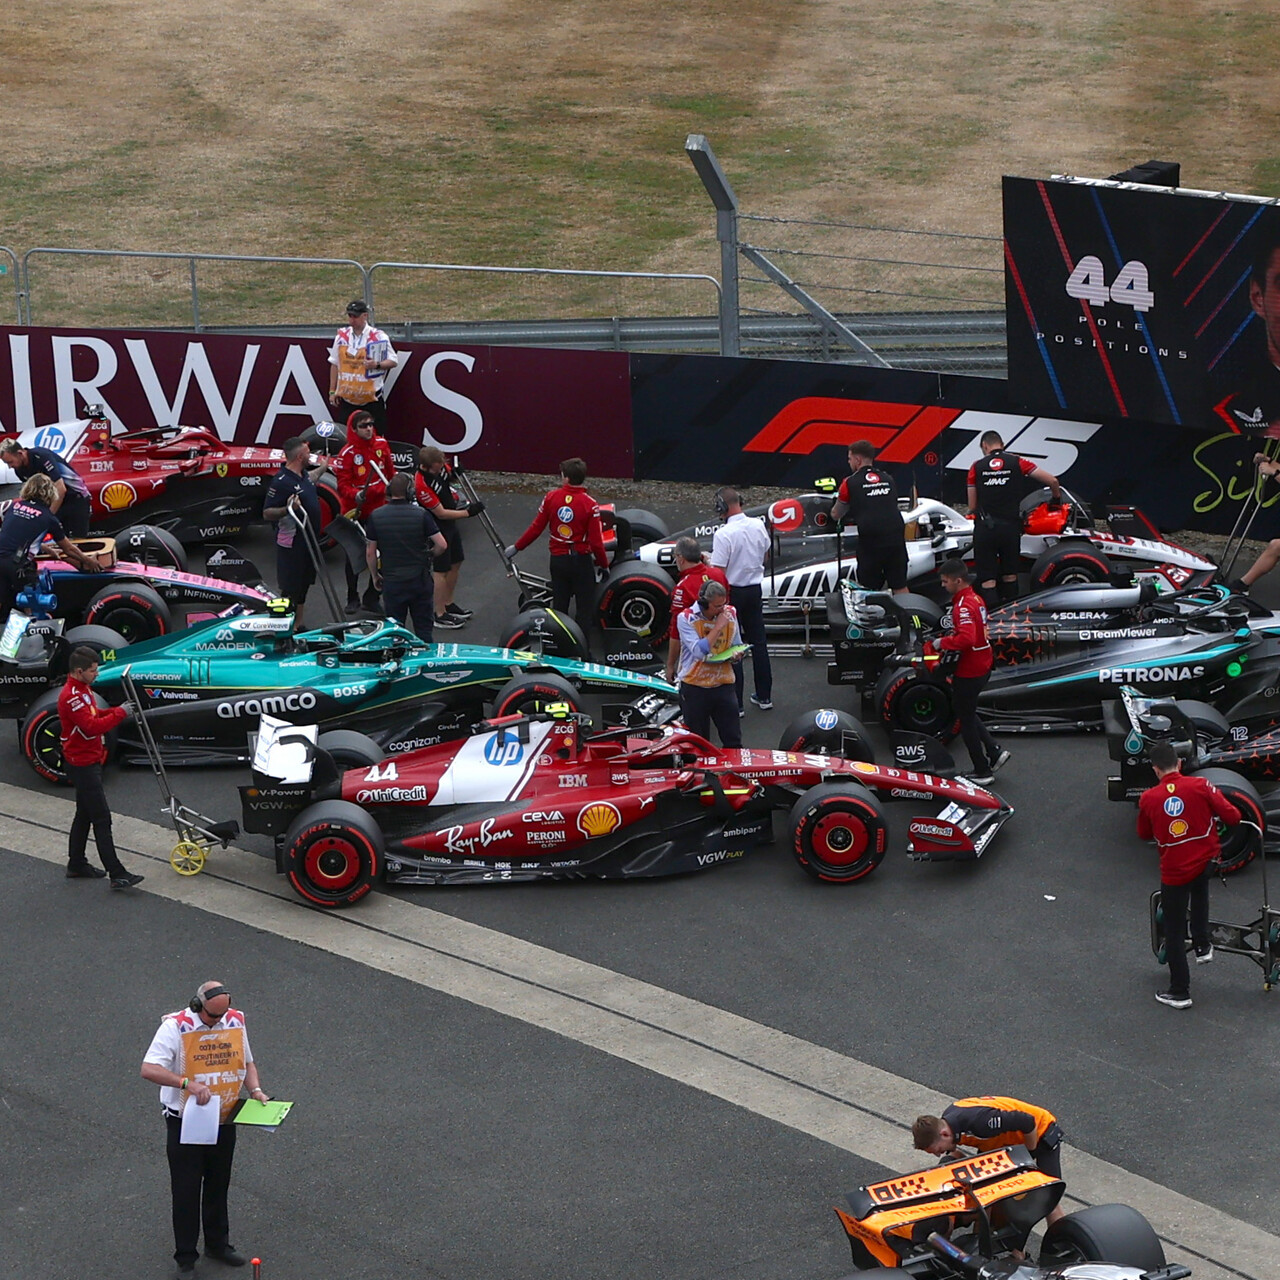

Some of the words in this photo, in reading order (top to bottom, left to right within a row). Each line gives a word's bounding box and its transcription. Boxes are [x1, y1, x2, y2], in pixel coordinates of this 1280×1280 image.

[1066, 255, 1154, 312] 44
[1079, 315, 1143, 332] POLE
[1036, 333, 1188, 360] POSITIONS
[317, 422, 334, 437] hp
[36, 425, 66, 454] hp
[742, 397, 962, 463] F1
[945, 410, 1103, 477] 75
[391, 452, 413, 463] aws
[90, 461, 114, 471] IBM
[132, 461, 147, 470] aws
[199, 525, 225, 538] VGW
[694, 514, 766, 537] Monem
[183, 588, 223, 601] INFINOX
[1060, 611, 1099, 620] SOLERA
[29, 626, 50, 636] arm
[253, 621, 290, 630] CoreWeave
[1090, 627, 1157, 640] TeamViewer
[195, 641, 256, 651] MAADEN
[101, 649, 116, 662] 14
[607, 651, 653, 662] coinbase
[131, 672, 182, 681] servicenow
[1098, 665, 1205, 683] PETRONAS
[161, 691, 199, 700] Valvoline
[333, 684, 367, 698] BOSS
[216, 692, 317, 719] aramco
[555, 725, 574, 734] ZCG
[1230, 726, 1249, 741] 12
[389, 734, 441, 751] cognizant
[896, 744, 925, 756] aws
[363, 762, 399, 782] 44
[611, 773, 628, 782] aws
[740, 770, 776, 779] RICHARD
[778, 768, 803, 778] MILLE
[558, 774, 588, 788] IBM
[259, 788, 305, 797] V-Power
[372, 785, 427, 802] UniCredit
[899, 788, 934, 800] UniCredit
[436, 817, 513, 853] Ray-Ban
[526, 830, 566, 841] PERONI
[723, 827, 758, 838] ambipar
[919, 823, 953, 837] UniCredit
[423, 854, 452, 865] brembo
[697, 849, 727, 866] VGW
[726, 850, 744, 859] PLAY
[997, 1177, 1025, 1191] App
